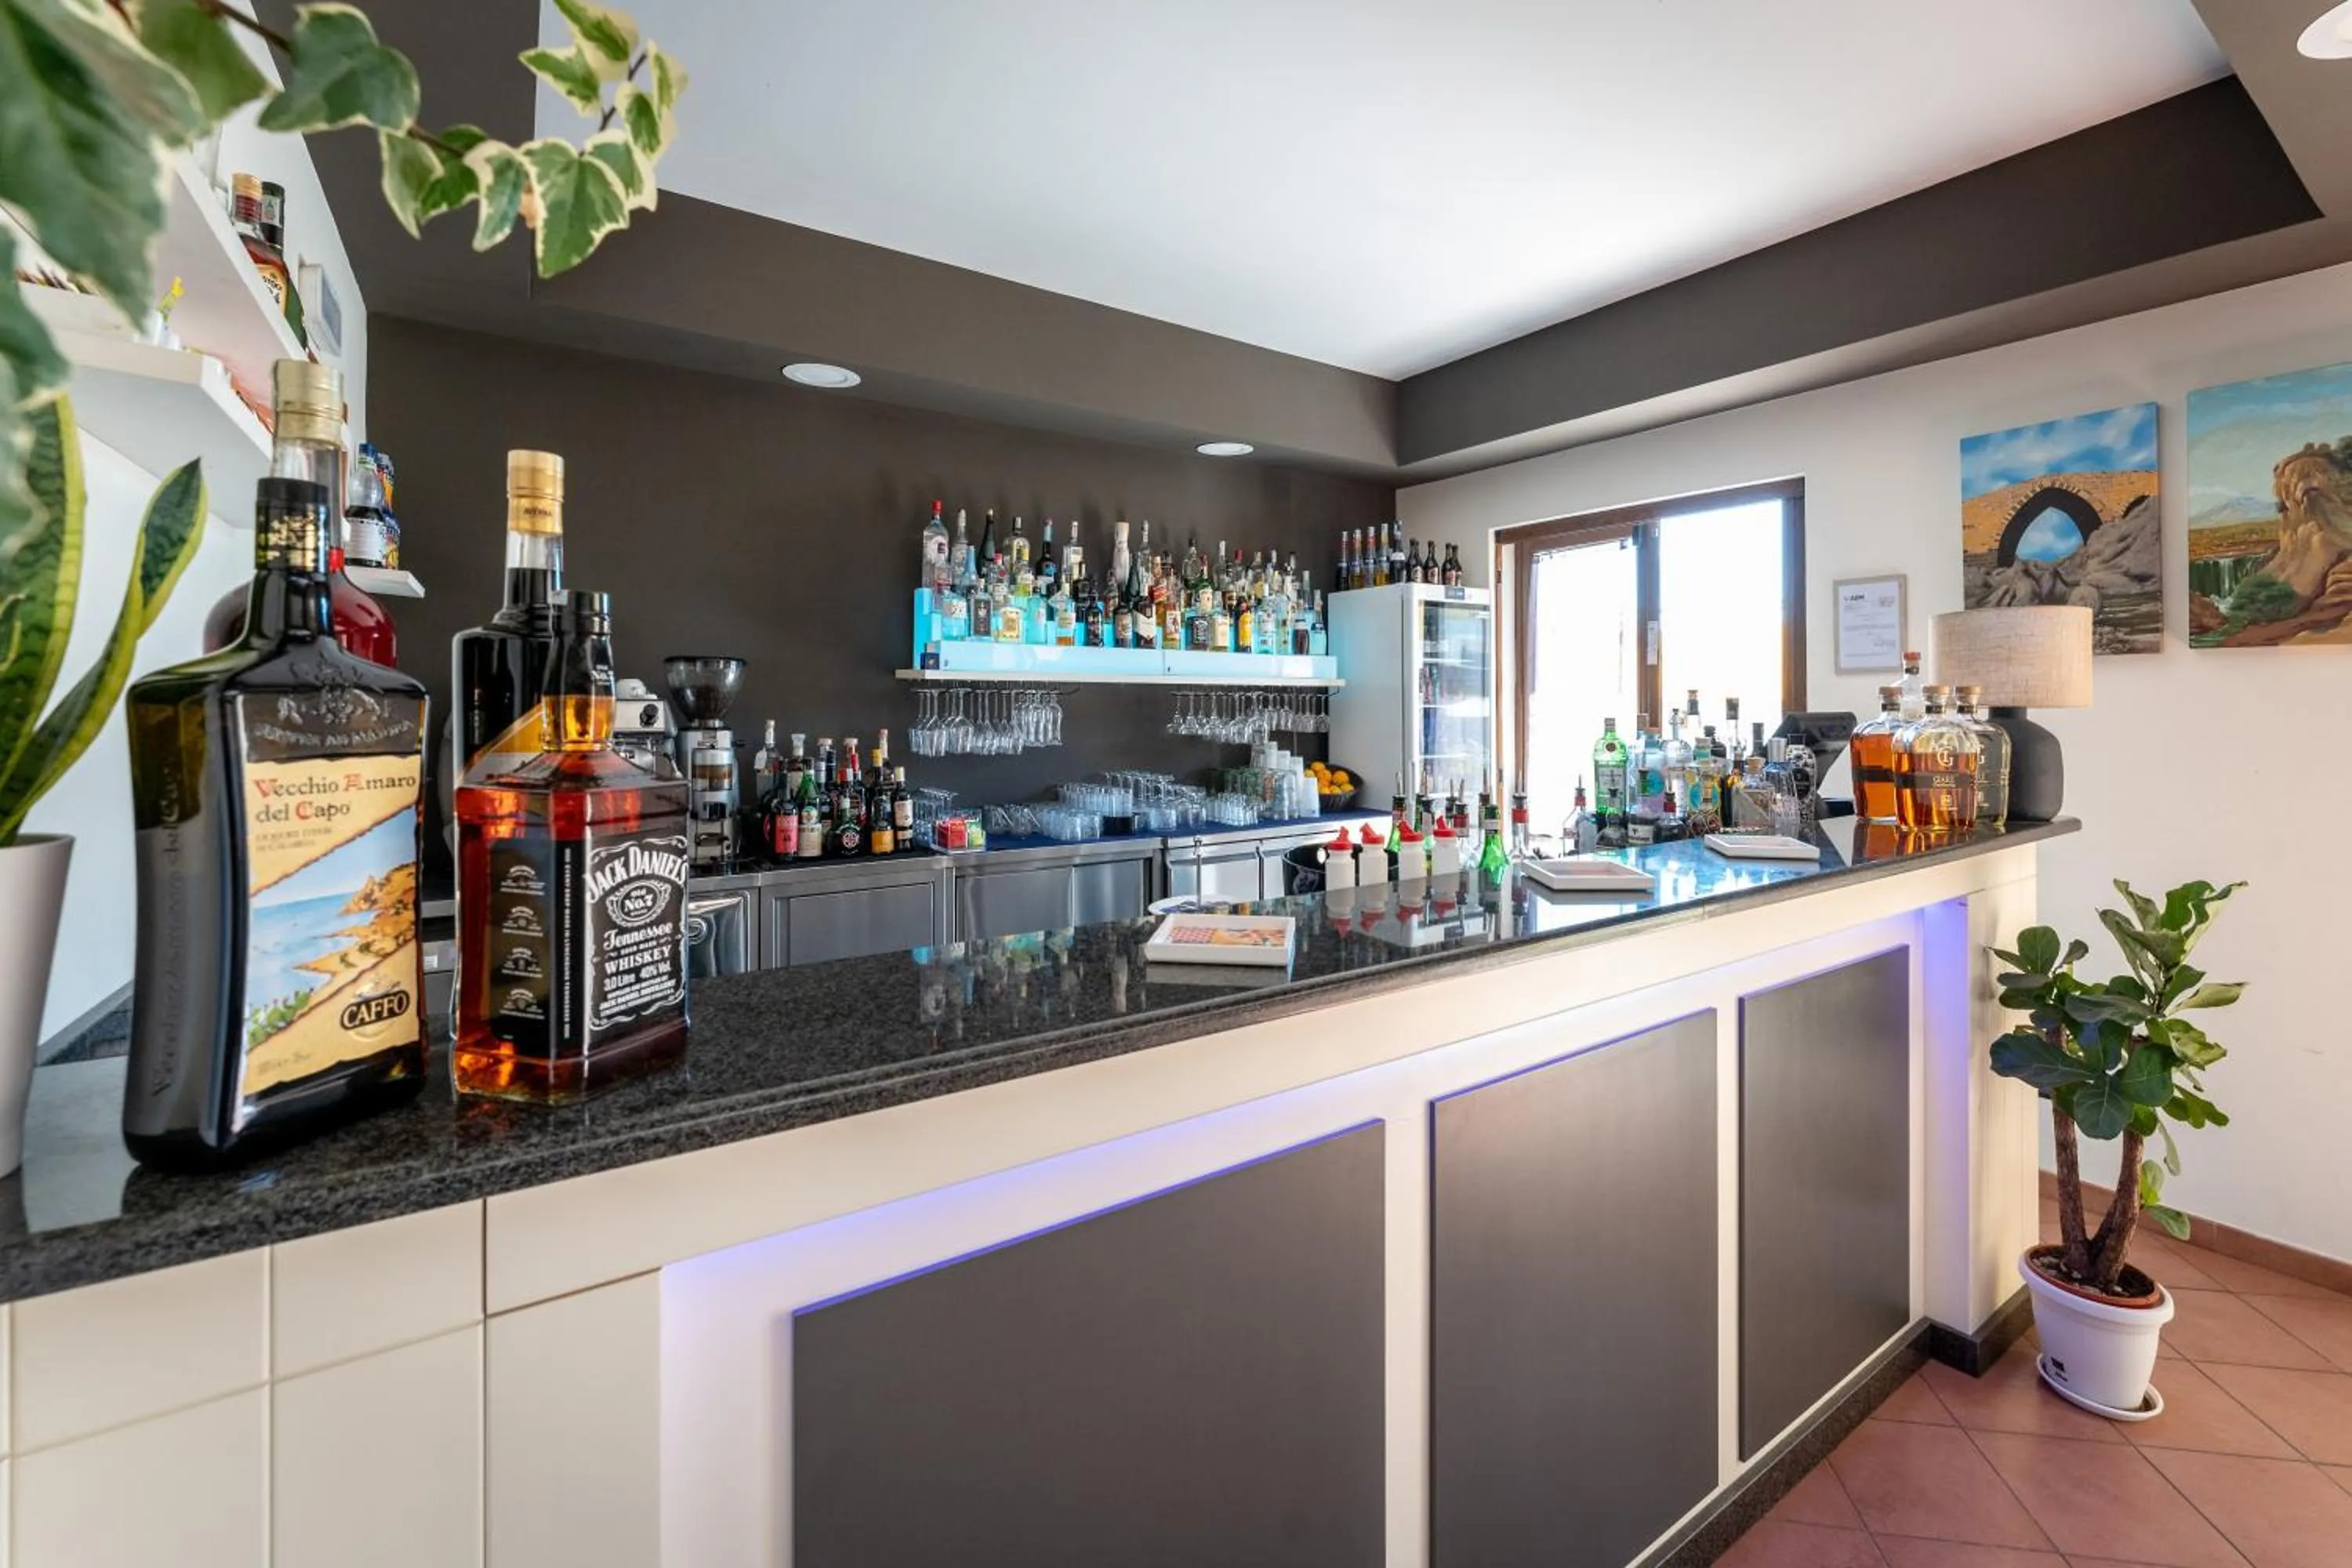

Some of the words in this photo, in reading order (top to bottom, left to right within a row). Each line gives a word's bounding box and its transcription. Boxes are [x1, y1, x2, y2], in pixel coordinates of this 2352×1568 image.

[252, 777, 339, 798] Vecchio
[342, 774, 416, 793] Amaro
[256, 804, 289, 823] del
[295, 800, 350, 821] Capo
[582, 856, 628, 904] JACK
[628, 846, 689, 886] DANIEL'S
[624, 894, 653, 913] No.7
[603, 922, 673, 951] Tennessee
[604, 944, 672, 975] WHISKEY
[343, 993, 408, 1029] CAFFO
